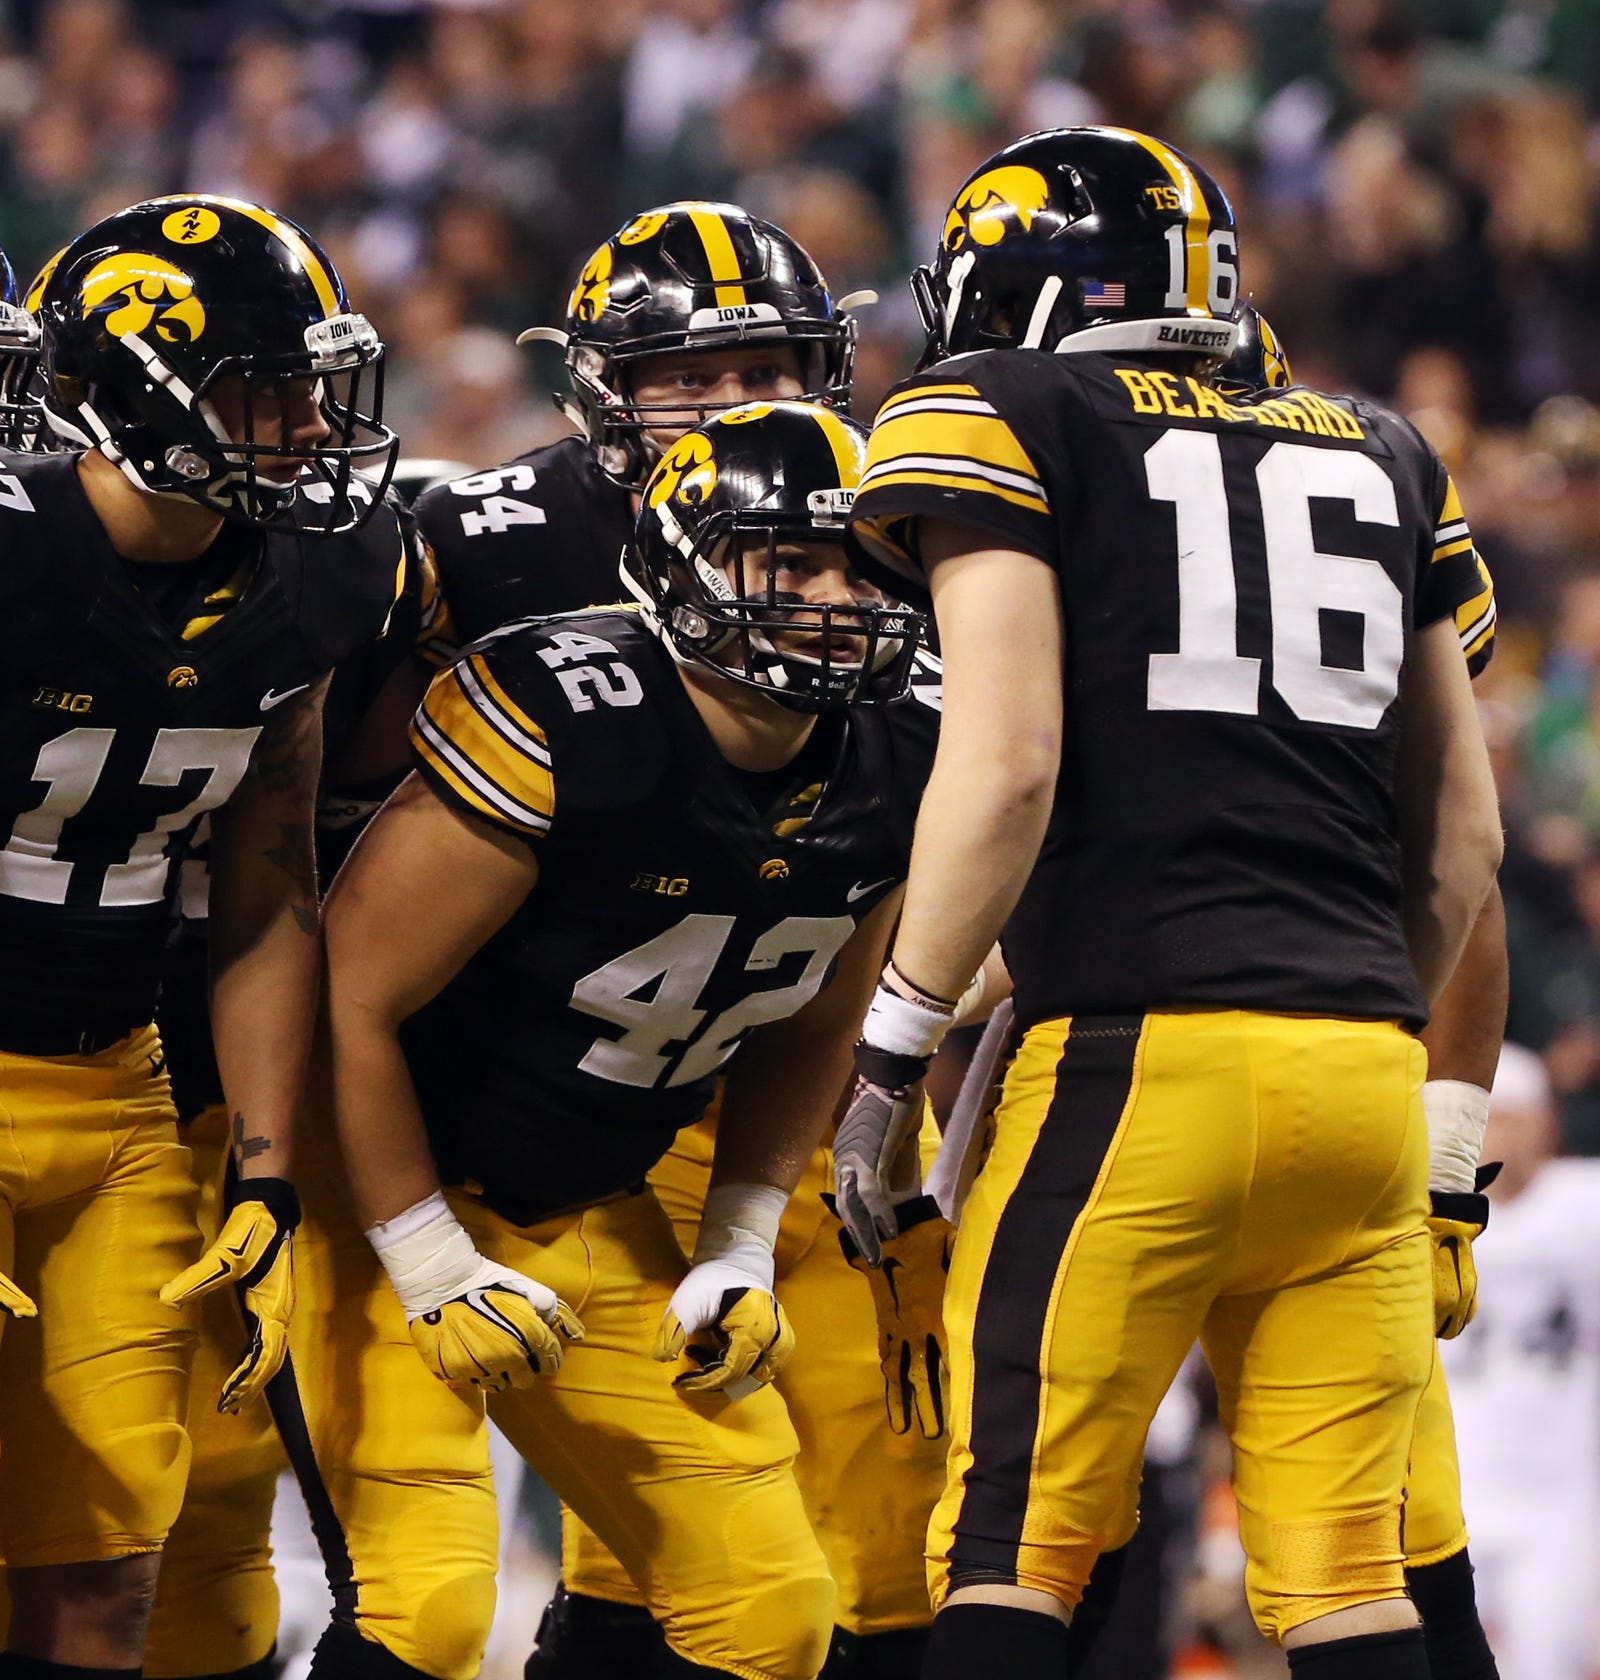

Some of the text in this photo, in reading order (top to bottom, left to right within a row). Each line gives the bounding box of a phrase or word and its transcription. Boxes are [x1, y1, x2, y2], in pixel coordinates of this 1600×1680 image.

[181, 209, 201, 241] ANF
[1145, 186, 1181, 210] TS
[1164, 224, 1238, 314] 16
[717, 306, 758, 322] IOWA
[1156, 325, 1232, 347] HAWKEYES
[448, 465, 547, 537] 64
[1143, 428, 1404, 730] 16
[536, 631, 644, 713] 42
[569, 913, 858, 1089] 42
